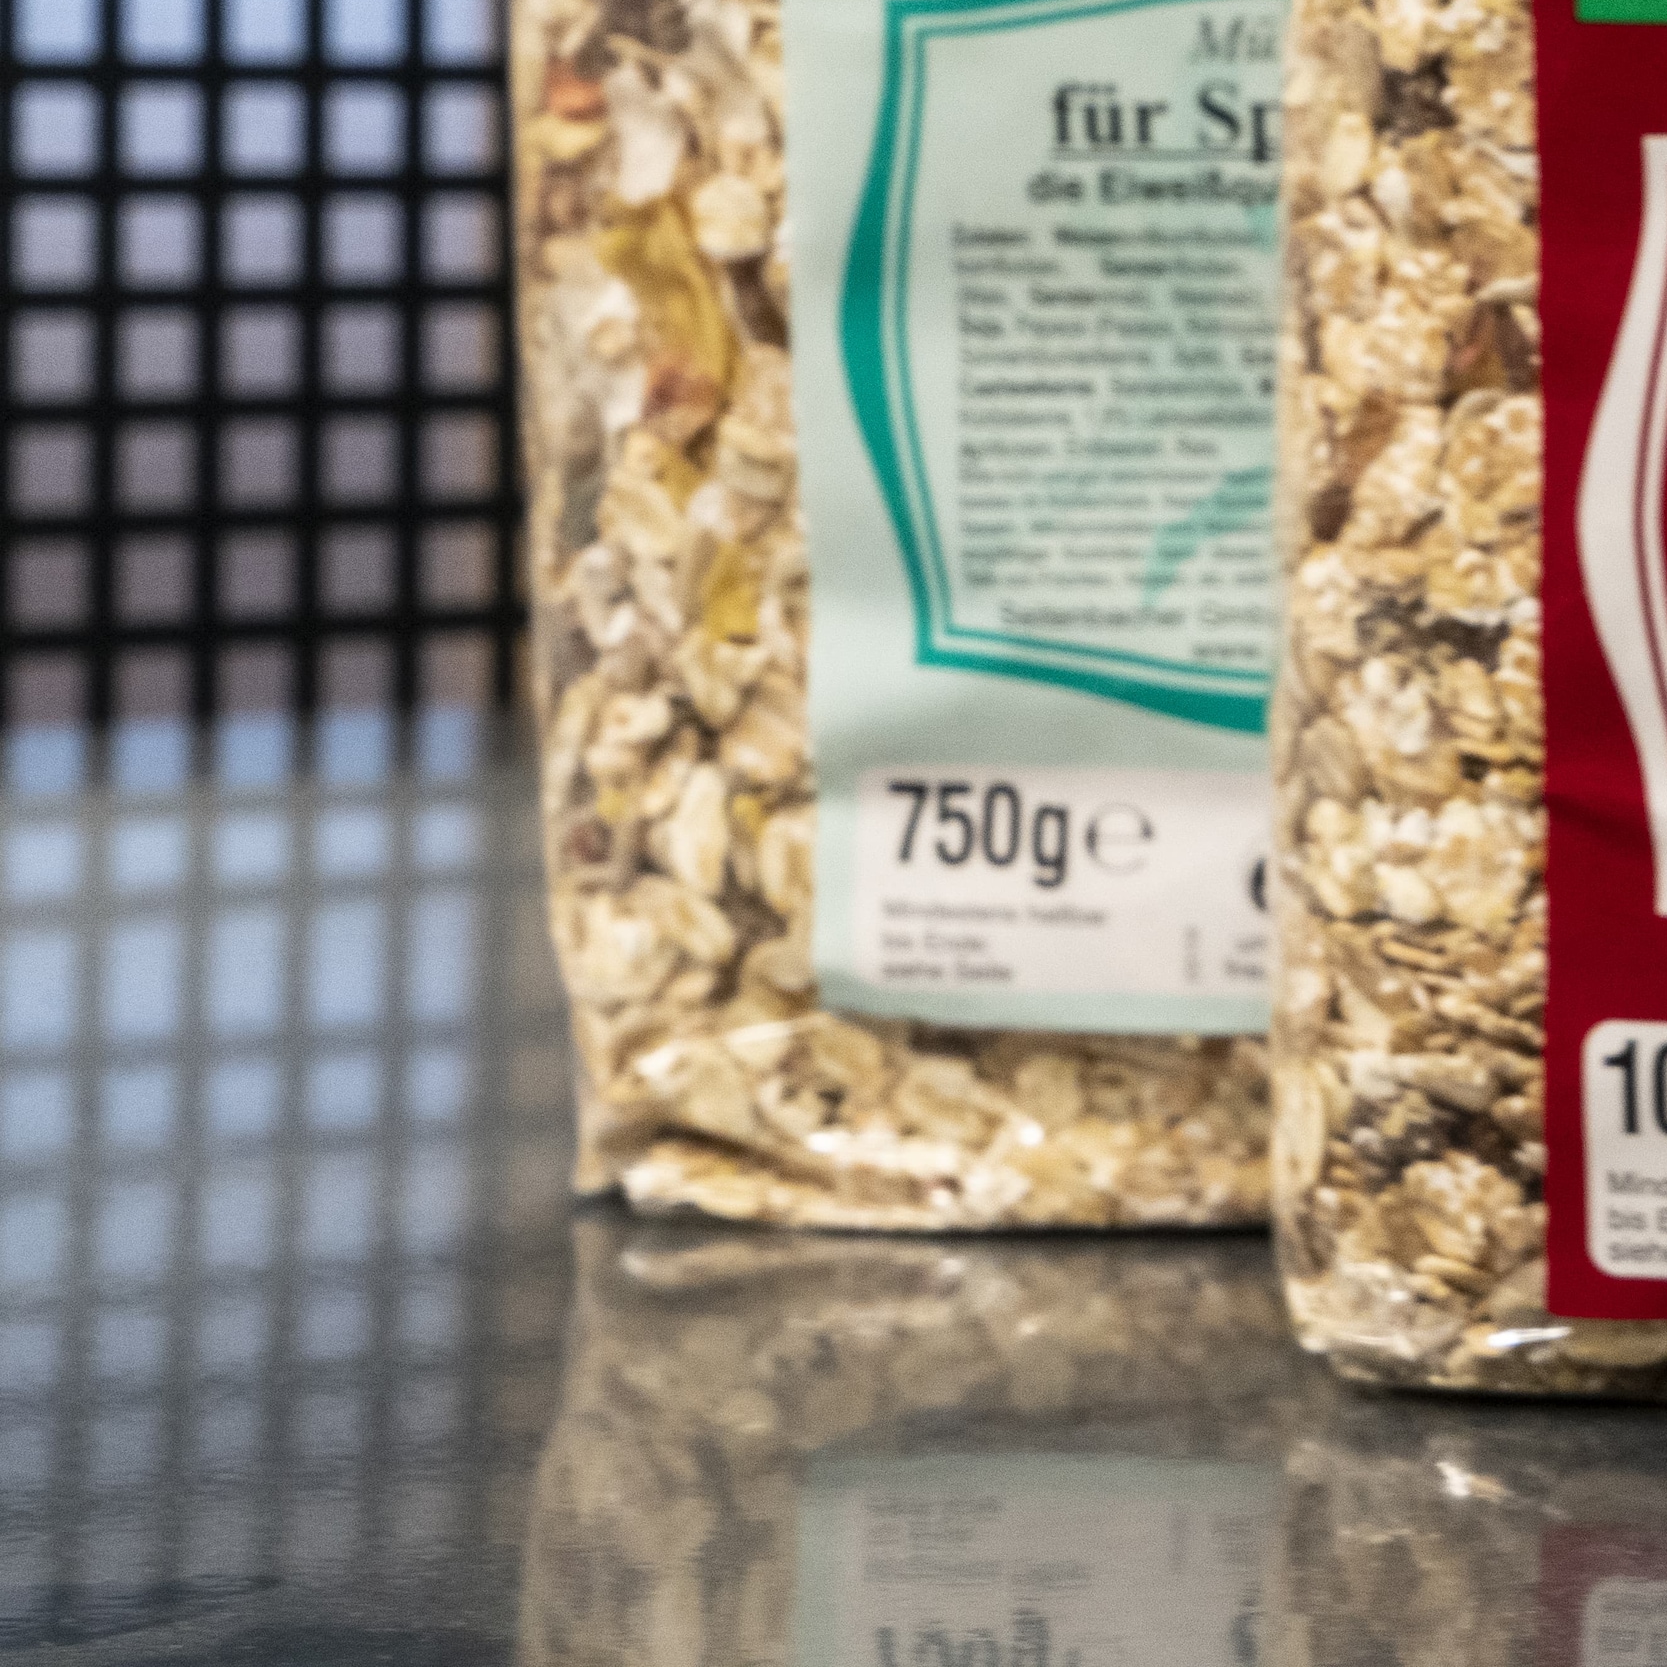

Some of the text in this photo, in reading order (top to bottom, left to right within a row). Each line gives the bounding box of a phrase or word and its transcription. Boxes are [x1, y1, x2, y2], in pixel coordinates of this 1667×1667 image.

[1050, 80, 1170, 153] für
[885, 778, 1073, 891] 750g
[1606, 1205, 1651, 1235] bis
